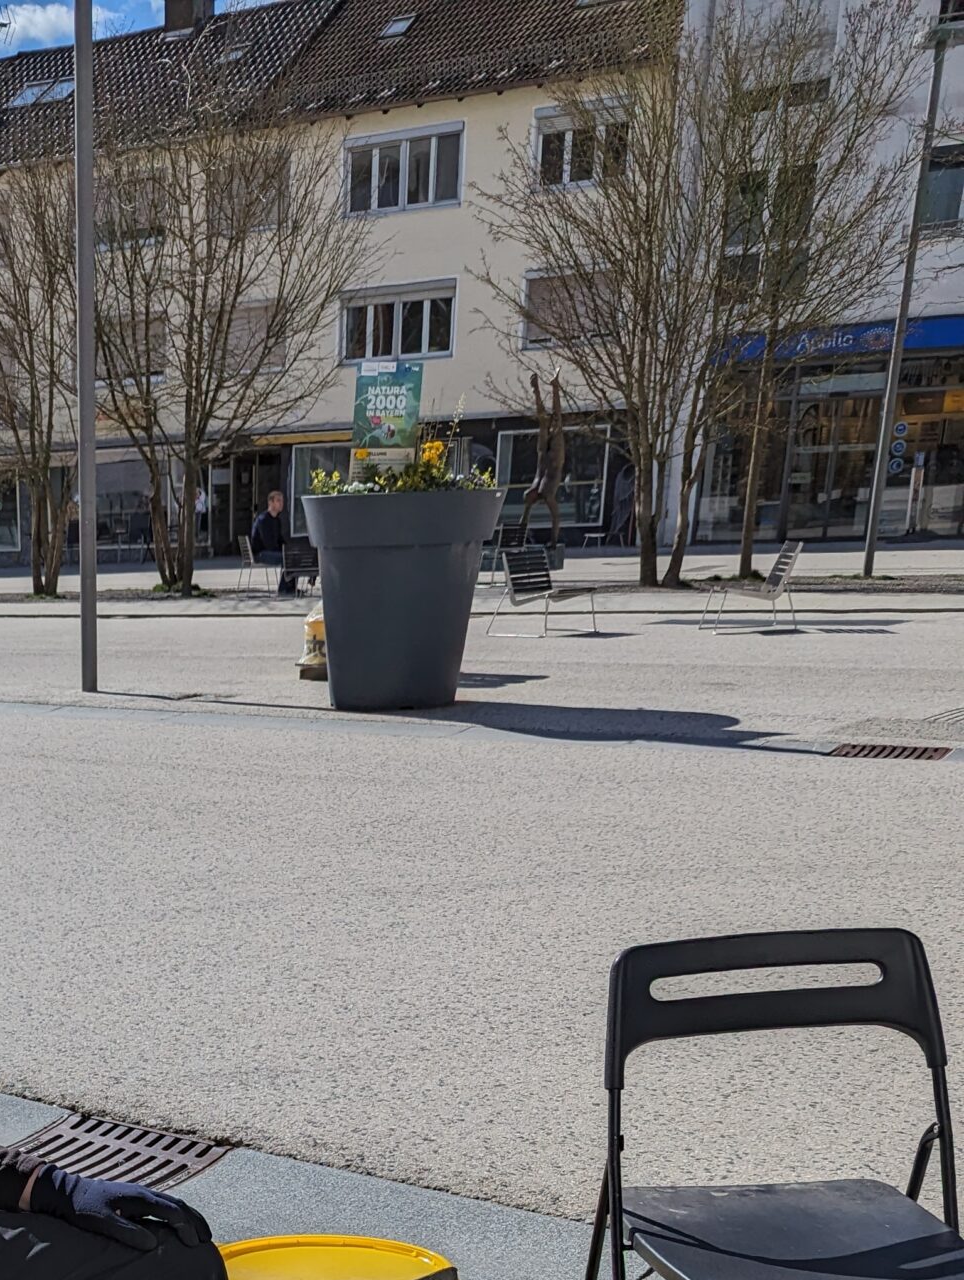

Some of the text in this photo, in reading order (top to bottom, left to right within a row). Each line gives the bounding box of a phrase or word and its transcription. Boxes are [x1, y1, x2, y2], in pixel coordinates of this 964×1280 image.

[368, 386, 407, 395] NATURA
[367, 395, 406, 410] 2000
[366, 409, 406, 417] IN BAYERN
